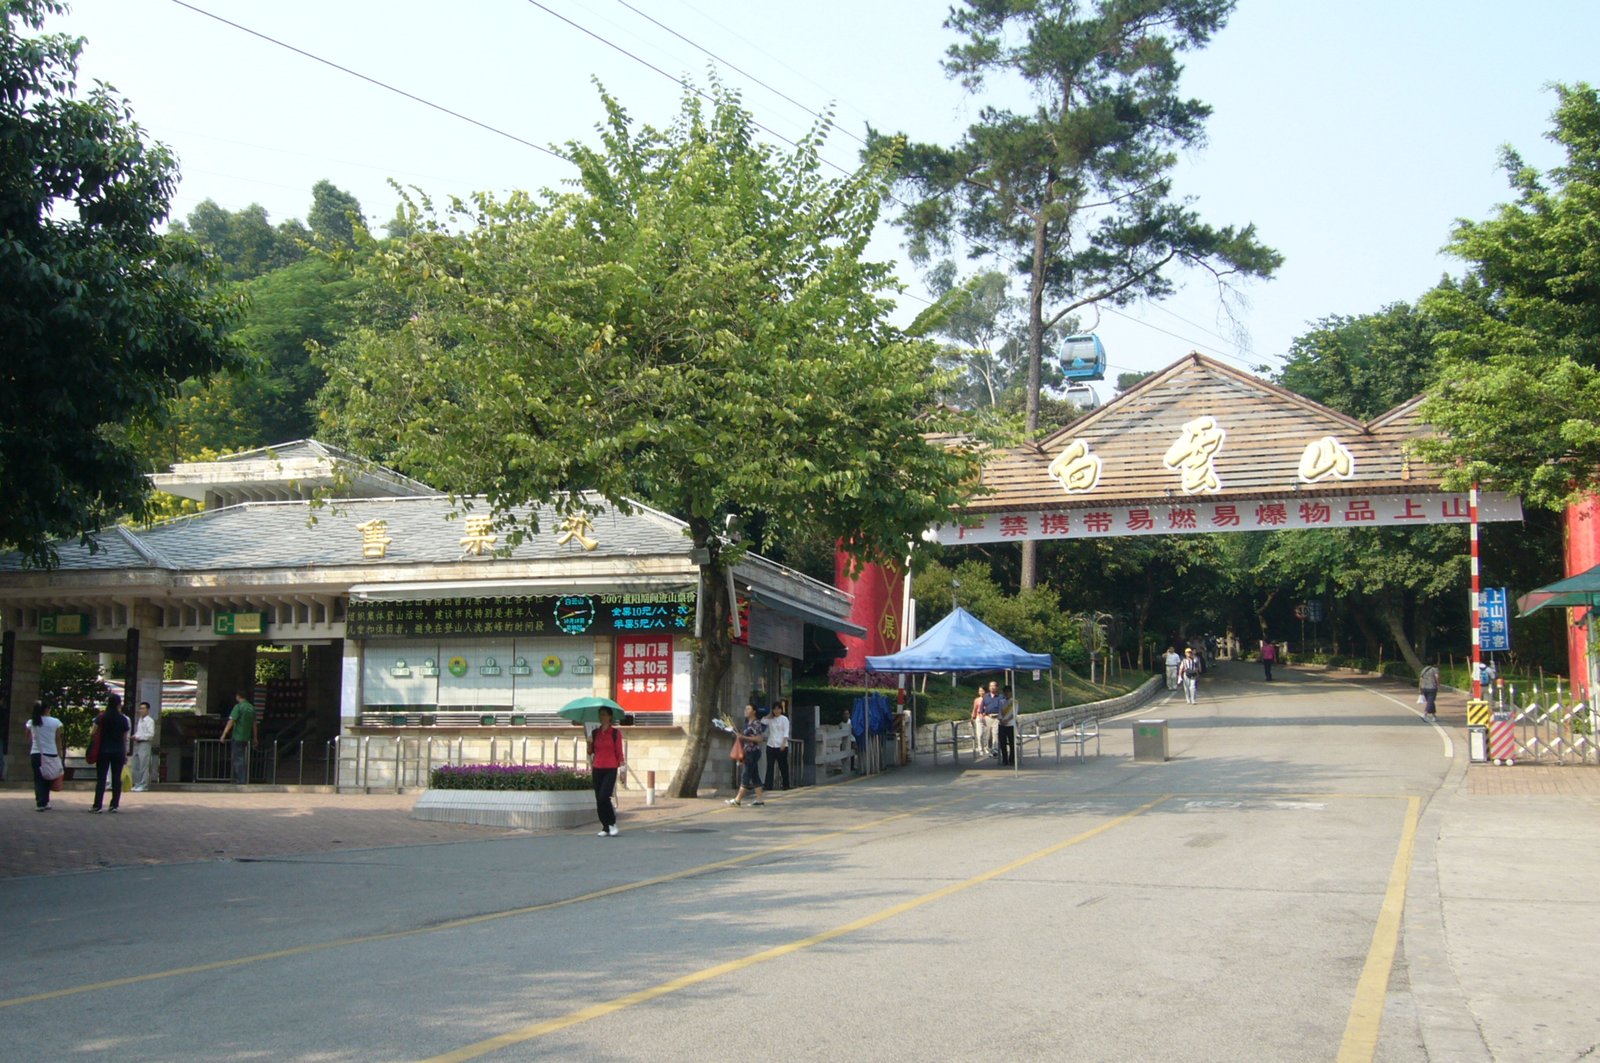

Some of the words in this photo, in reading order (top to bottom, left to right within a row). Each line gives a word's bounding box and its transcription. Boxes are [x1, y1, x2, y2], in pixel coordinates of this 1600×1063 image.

[1490, 591, 1504, 647] 上山游客
[623, 642, 669, 658] 重阳门票
[622, 661, 668, 676] 全票10元
[622, 677, 668, 693] 半票5元
